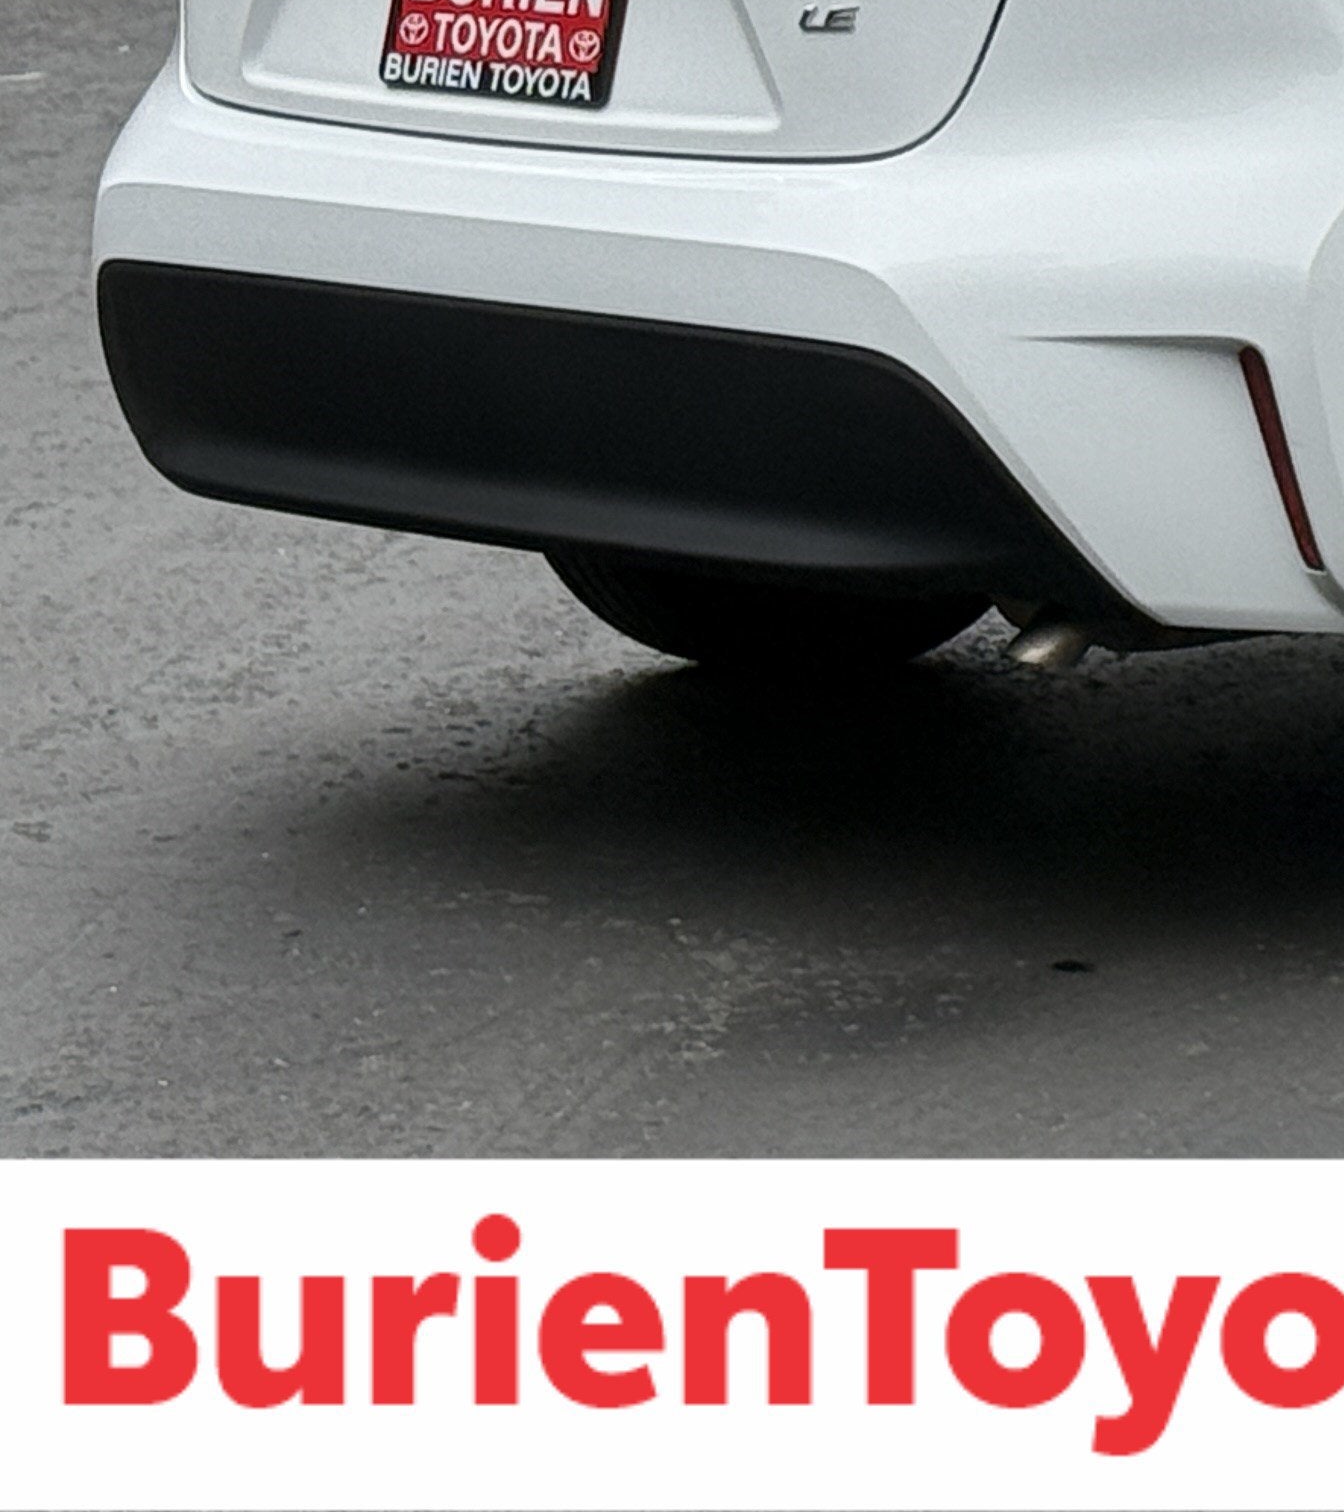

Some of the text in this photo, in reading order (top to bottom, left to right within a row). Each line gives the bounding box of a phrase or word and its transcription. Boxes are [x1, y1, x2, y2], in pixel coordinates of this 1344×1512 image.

[434, 12, 563, 64] TOYOTA
[798, 5, 861, 35] LE
[383, 52, 592, 102] BURIEN TOYOTA
